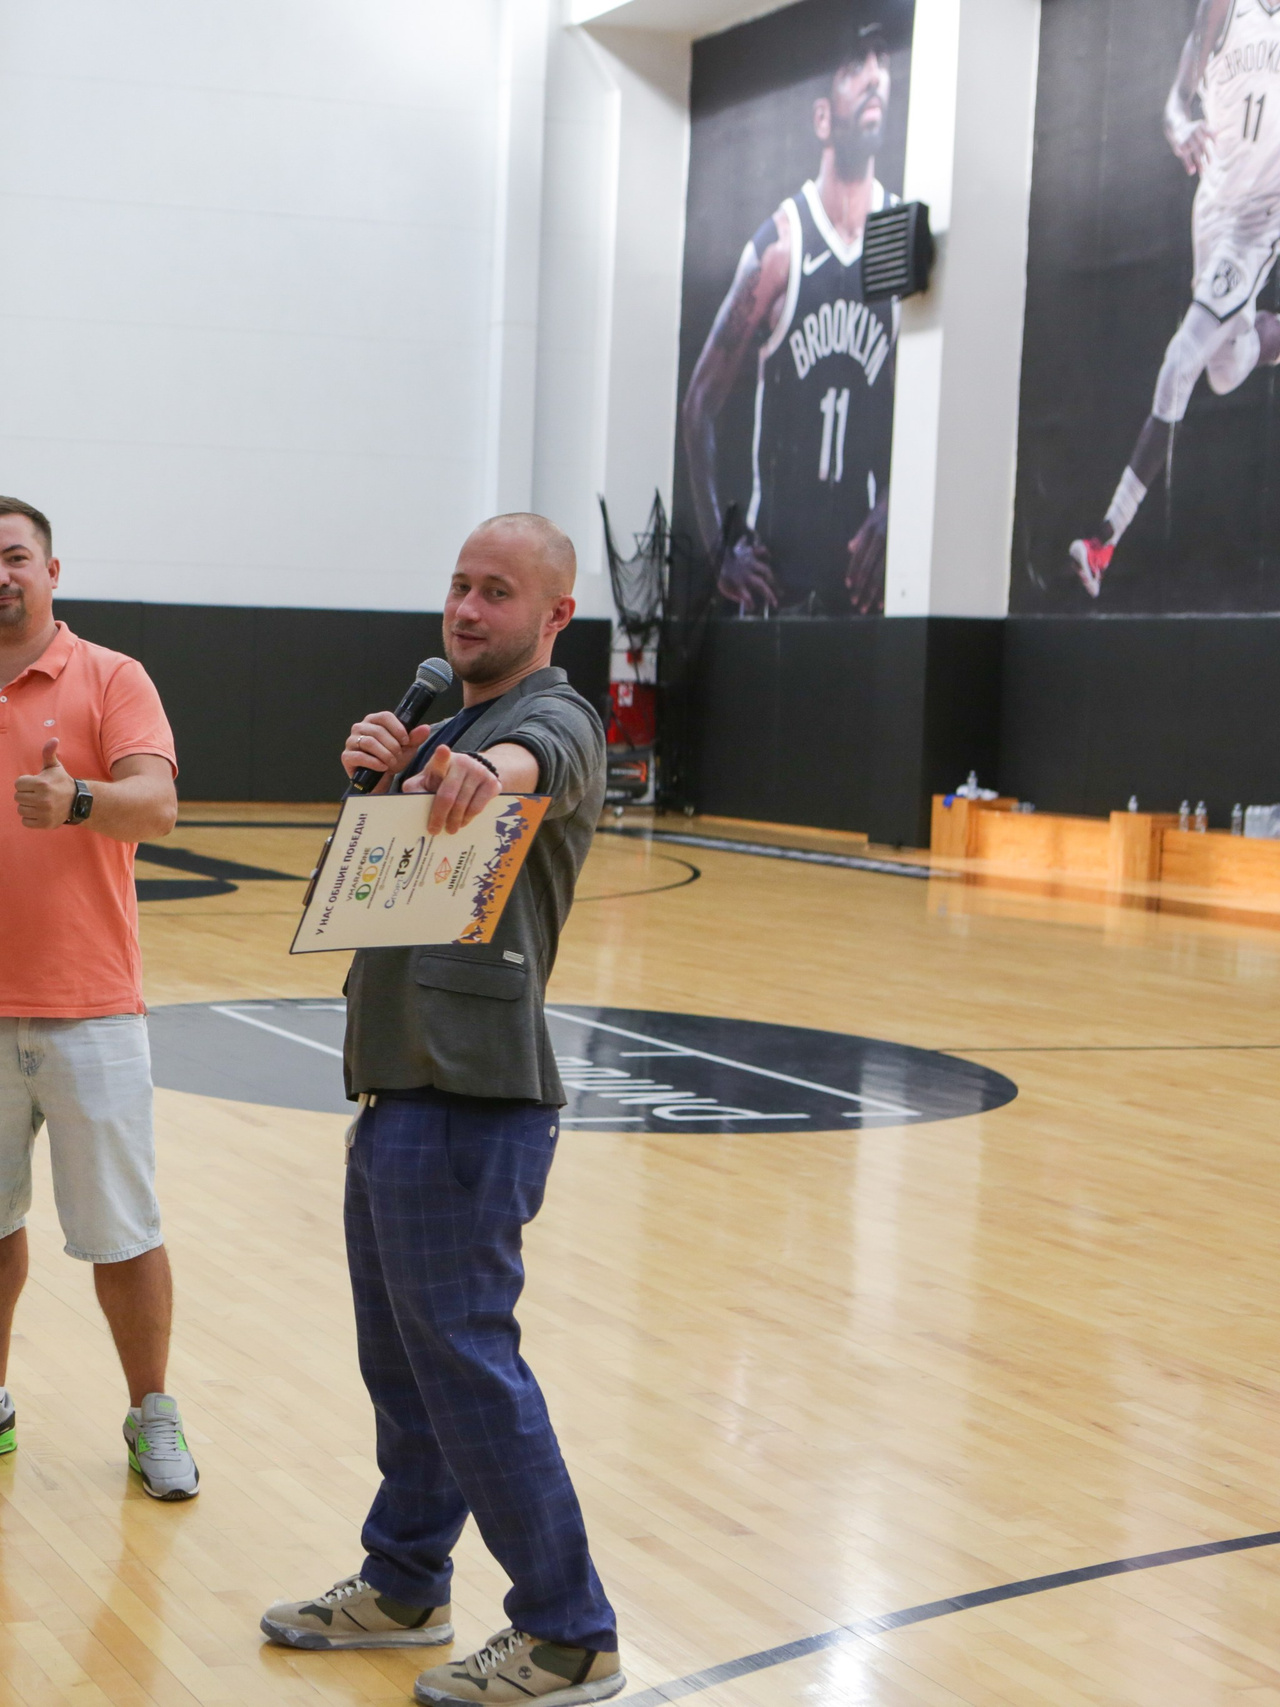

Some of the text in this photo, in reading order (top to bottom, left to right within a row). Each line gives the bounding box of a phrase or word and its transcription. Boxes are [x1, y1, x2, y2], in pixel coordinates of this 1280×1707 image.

[1242, 93, 1266, 142] 11
[789, 299, 889, 387] BROOKLYN
[818, 387, 851, 483] 11
[319, 905, 334, 926] НАС
[328, 865, 349, 903] ОБЩИЕ
[343, 813, 368, 863] ПОБЕДЫ!
[448, 850, 468, 890] UNEVENTS
